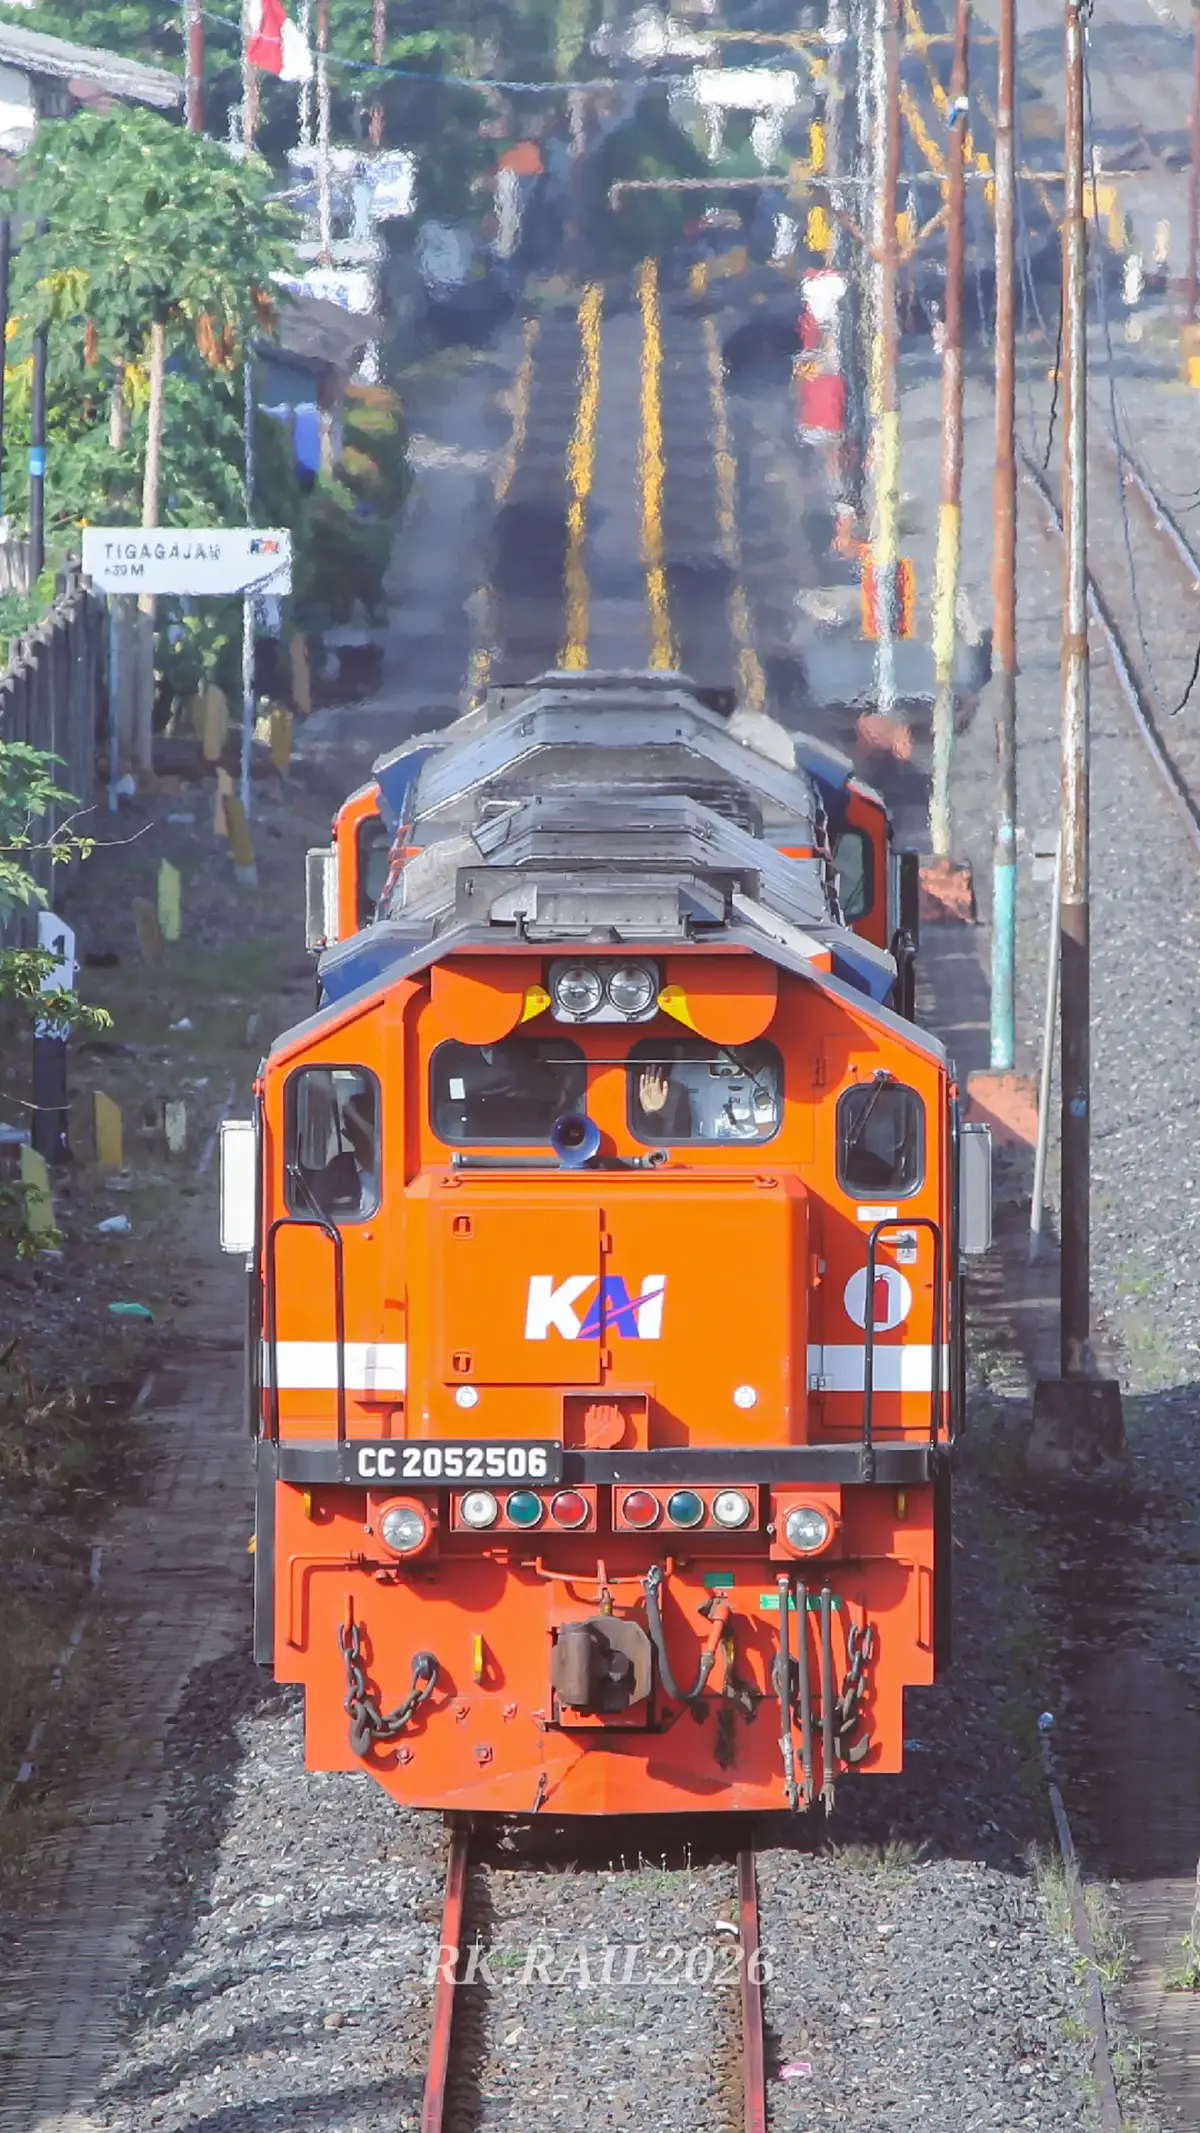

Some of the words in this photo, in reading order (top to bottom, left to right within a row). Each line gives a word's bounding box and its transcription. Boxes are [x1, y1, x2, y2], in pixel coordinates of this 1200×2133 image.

[525, 1274, 667, 1340] KAI
[357, 1447, 396, 1478] CC
[402, 1447, 548, 1478] 2052506
